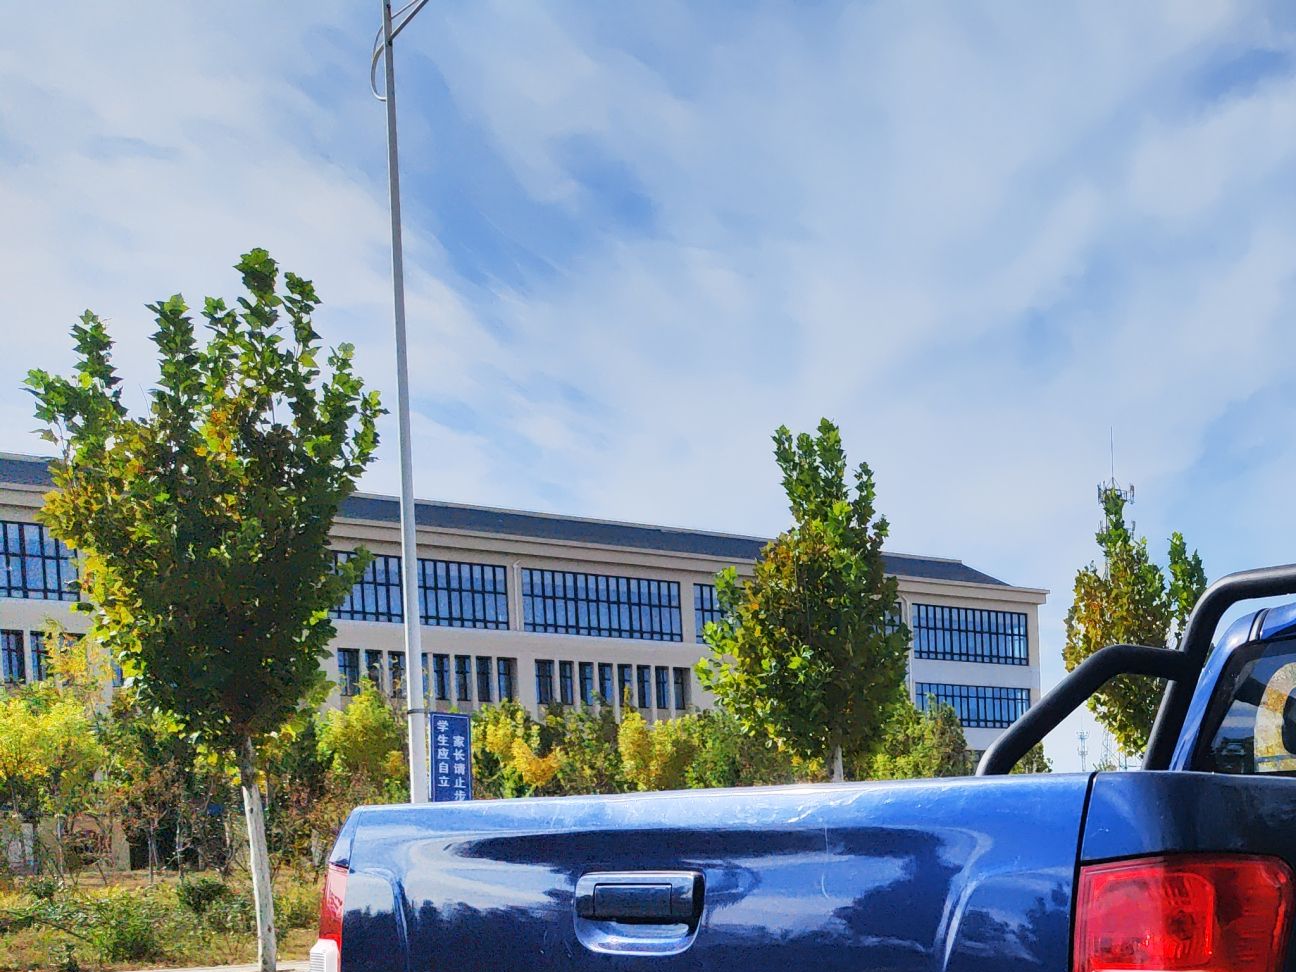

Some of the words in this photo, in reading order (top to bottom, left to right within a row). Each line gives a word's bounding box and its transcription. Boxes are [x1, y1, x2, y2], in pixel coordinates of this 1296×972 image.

[436, 719, 450, 787] 学生应自立
